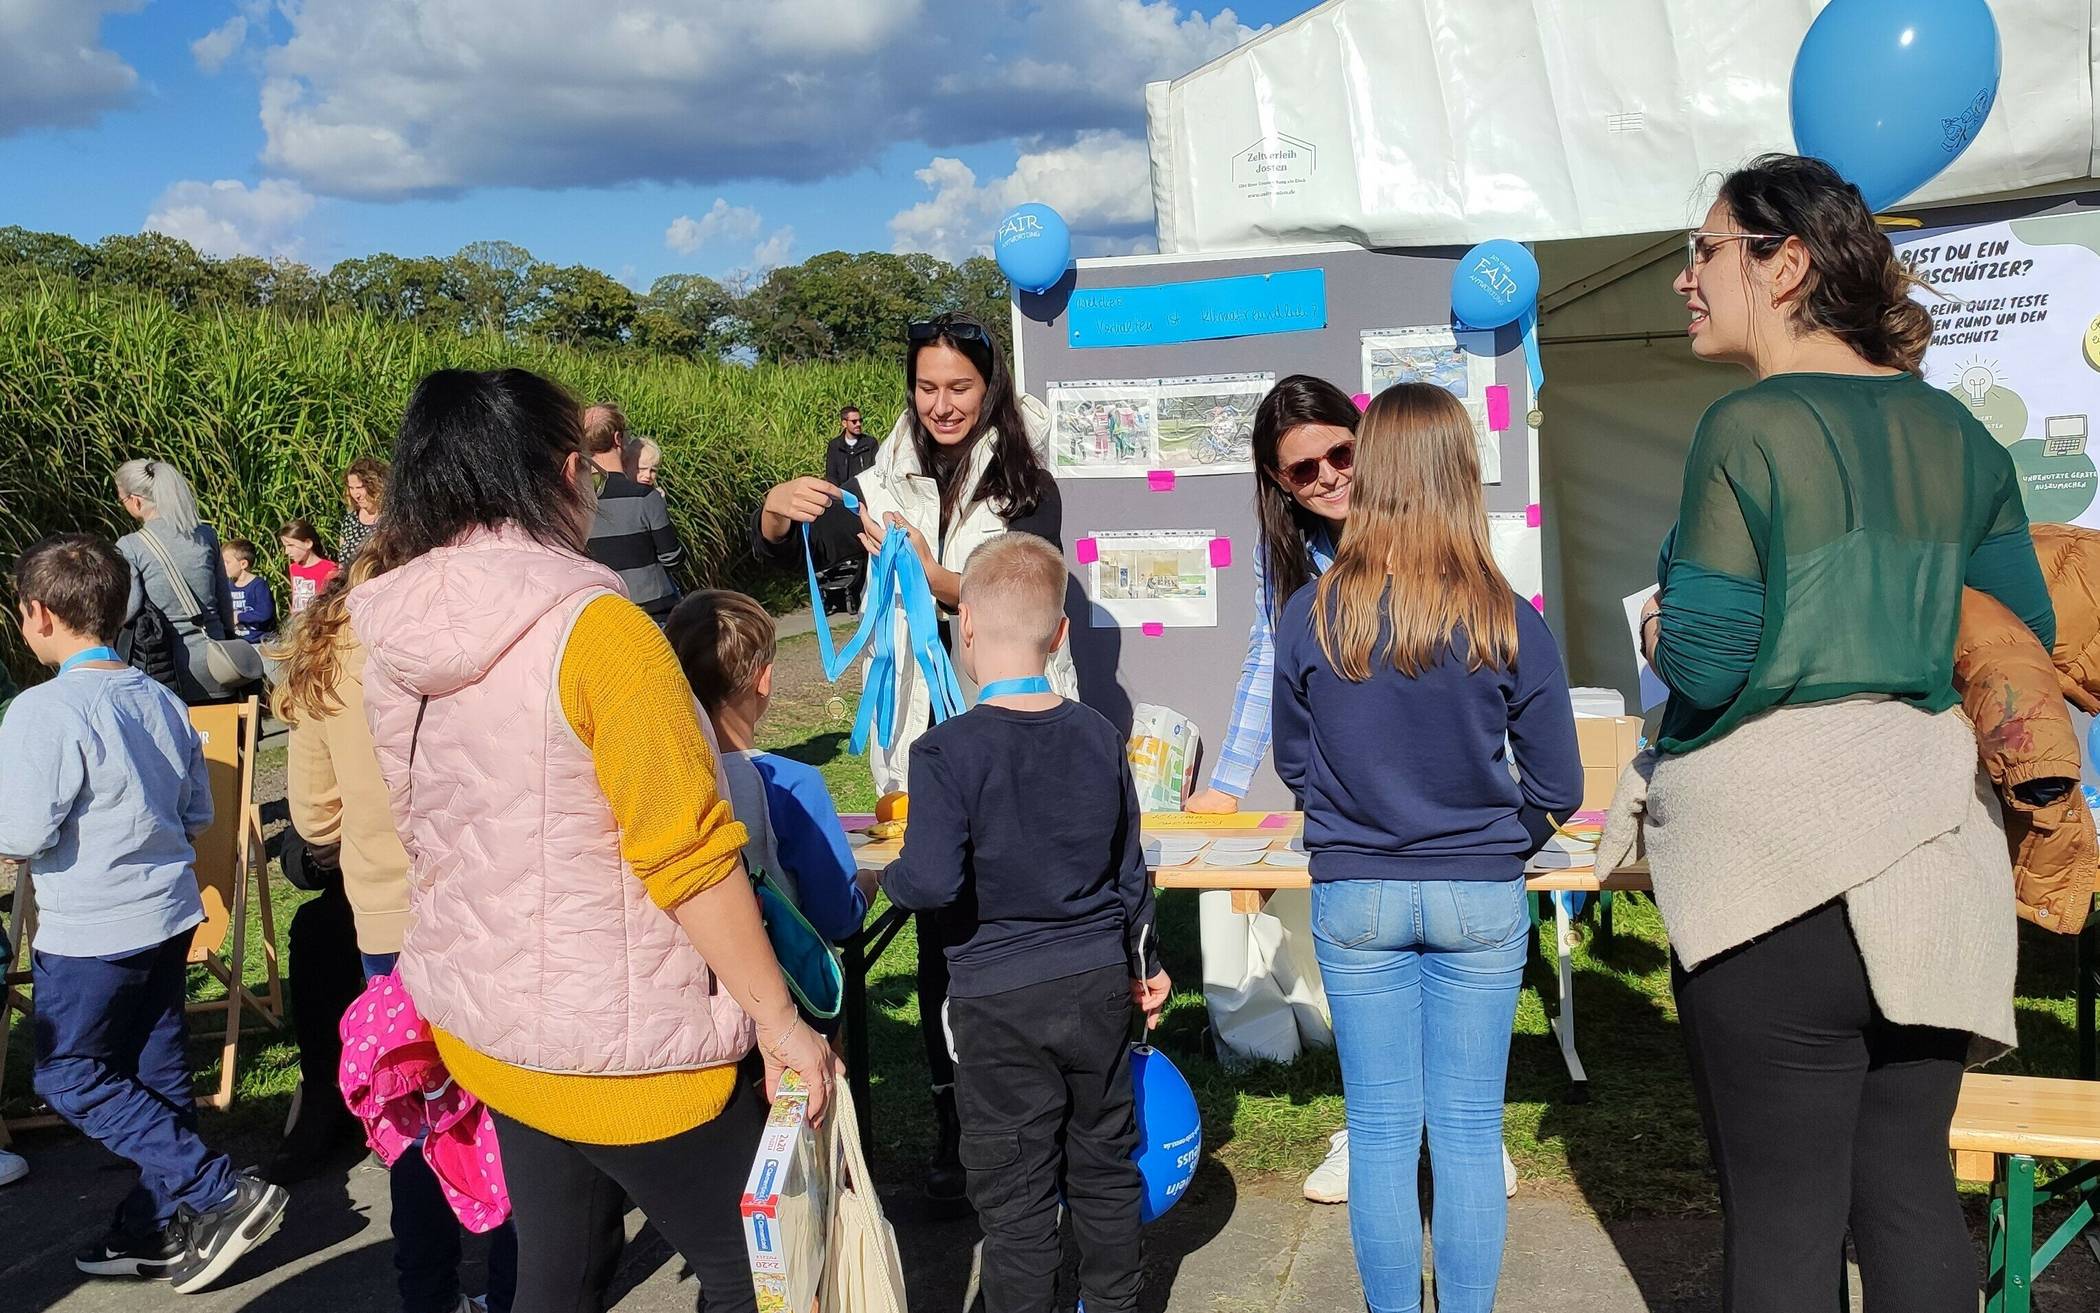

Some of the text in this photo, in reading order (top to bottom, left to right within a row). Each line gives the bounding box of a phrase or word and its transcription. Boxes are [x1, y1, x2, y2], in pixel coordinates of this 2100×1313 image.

[999, 215, 1043, 242] FAIR
[1900, 240, 2010, 265] BIST DU EIN
[1473, 257, 1517, 303] FAIR
[1919, 260, 2034, 284] ASCHÜTZER?
[1930, 294, 2049, 316] BEIM QUIZ! TESTE
[1932, 310, 2048, 331] EN RUND UM DEN
[1930, 329, 1999, 346] MASCHUTZ
[2034, 481, 2087, 491] AUSZUMACHEN
